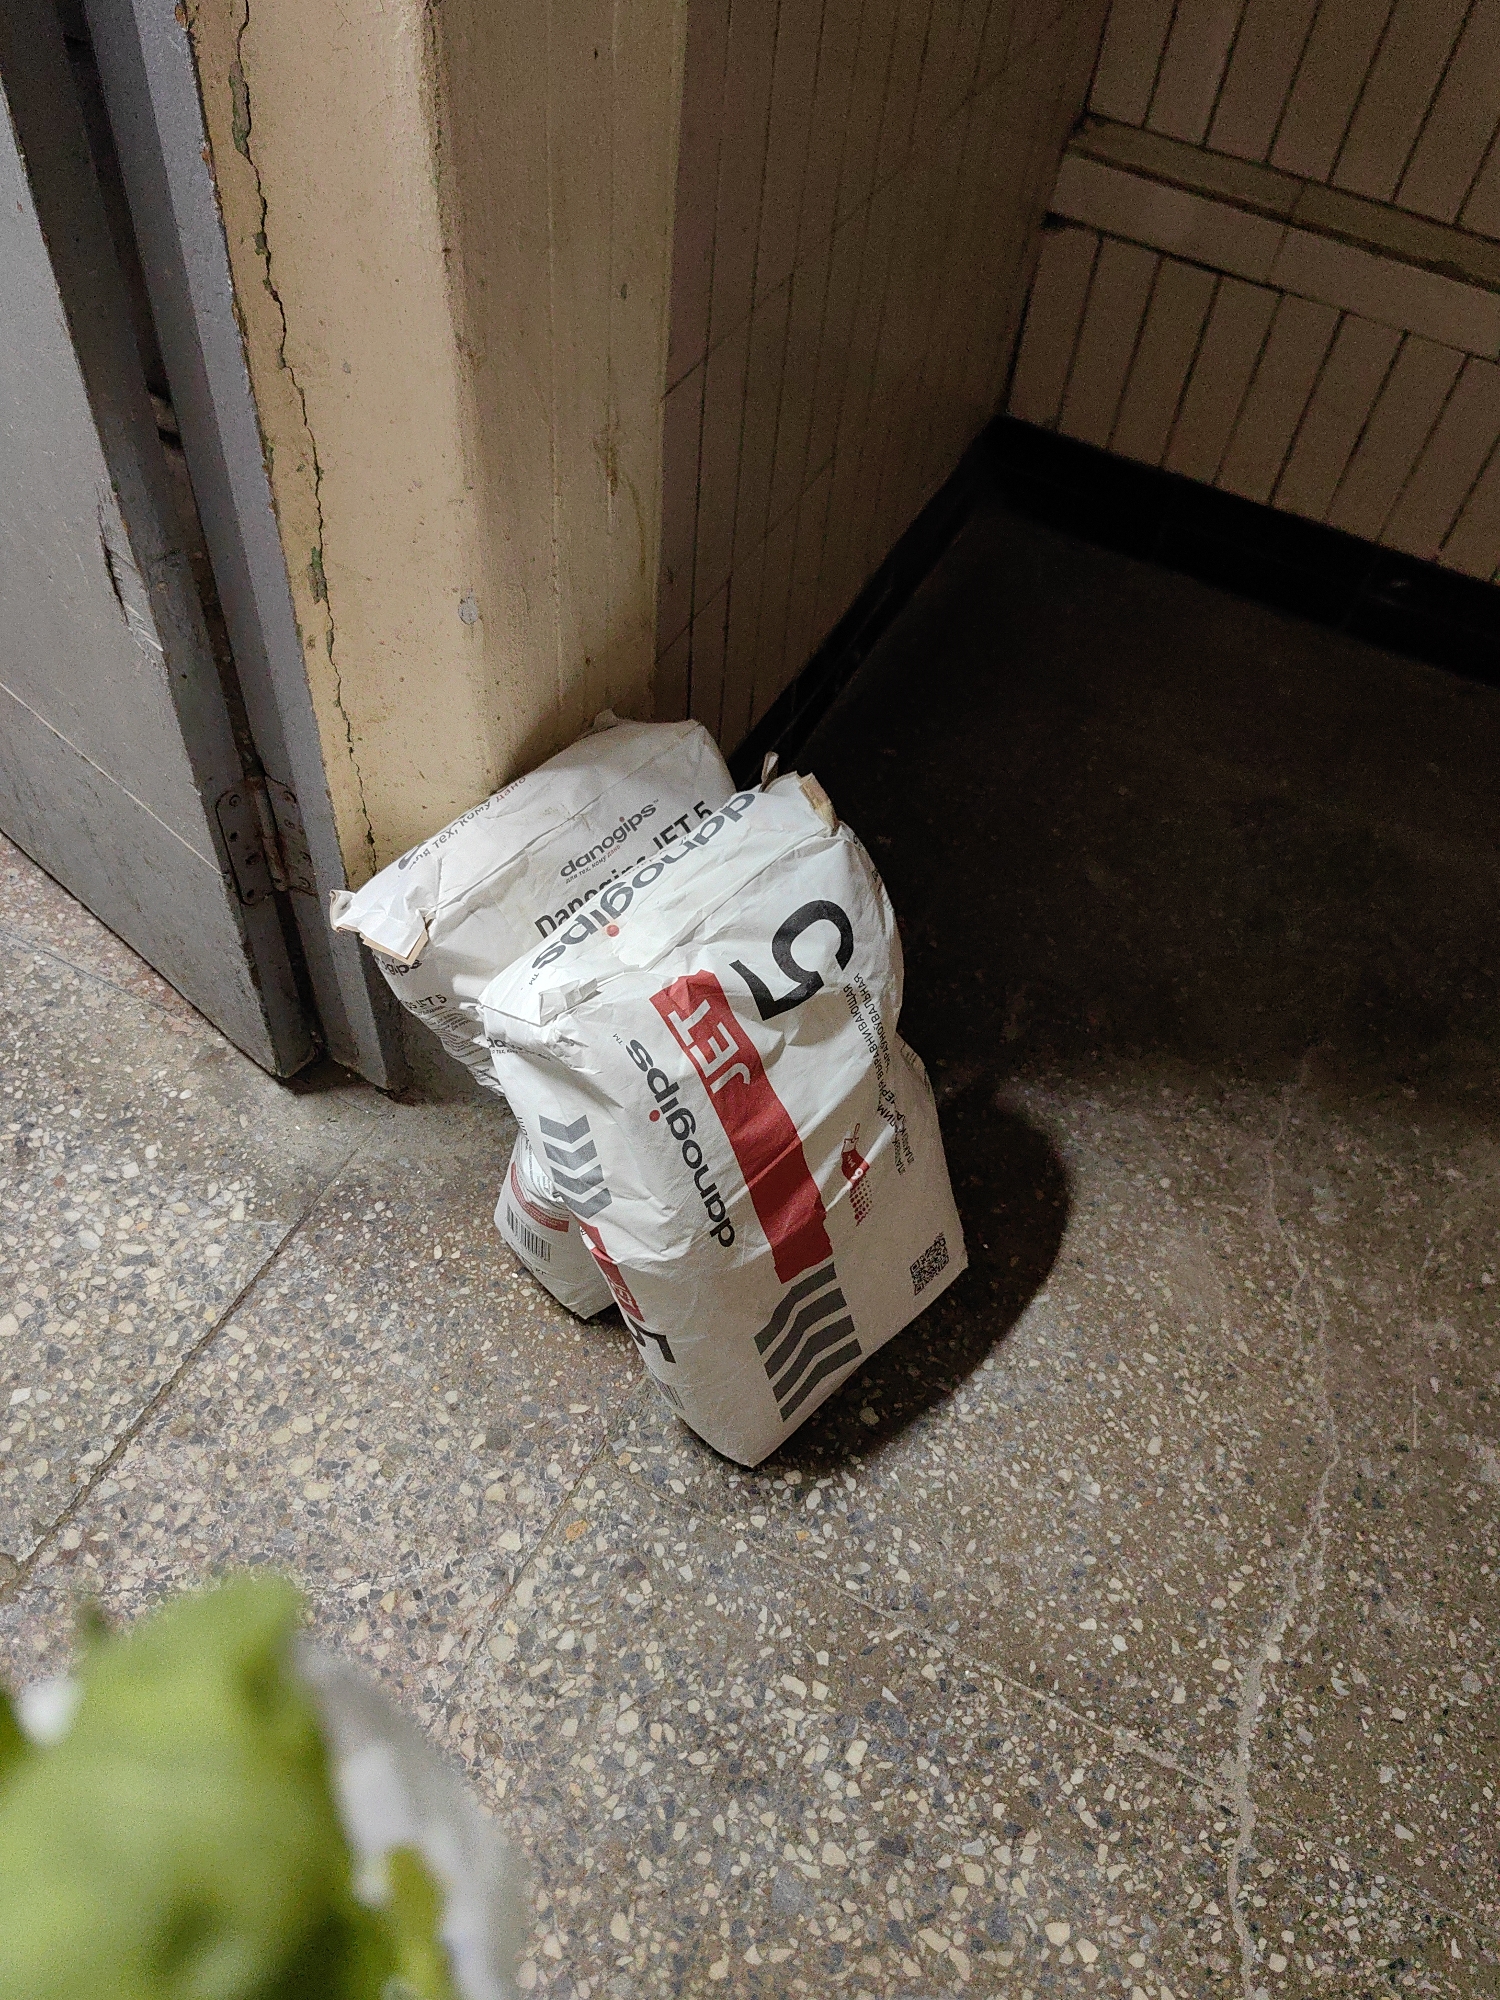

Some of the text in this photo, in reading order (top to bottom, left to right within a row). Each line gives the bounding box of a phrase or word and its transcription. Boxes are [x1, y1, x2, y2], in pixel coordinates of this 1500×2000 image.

[560, 803, 656, 878] danogips
[729, 900, 854, 1021] 5
[668, 999, 751, 1094] JET
[625, 1038, 735, 1248] danogips
